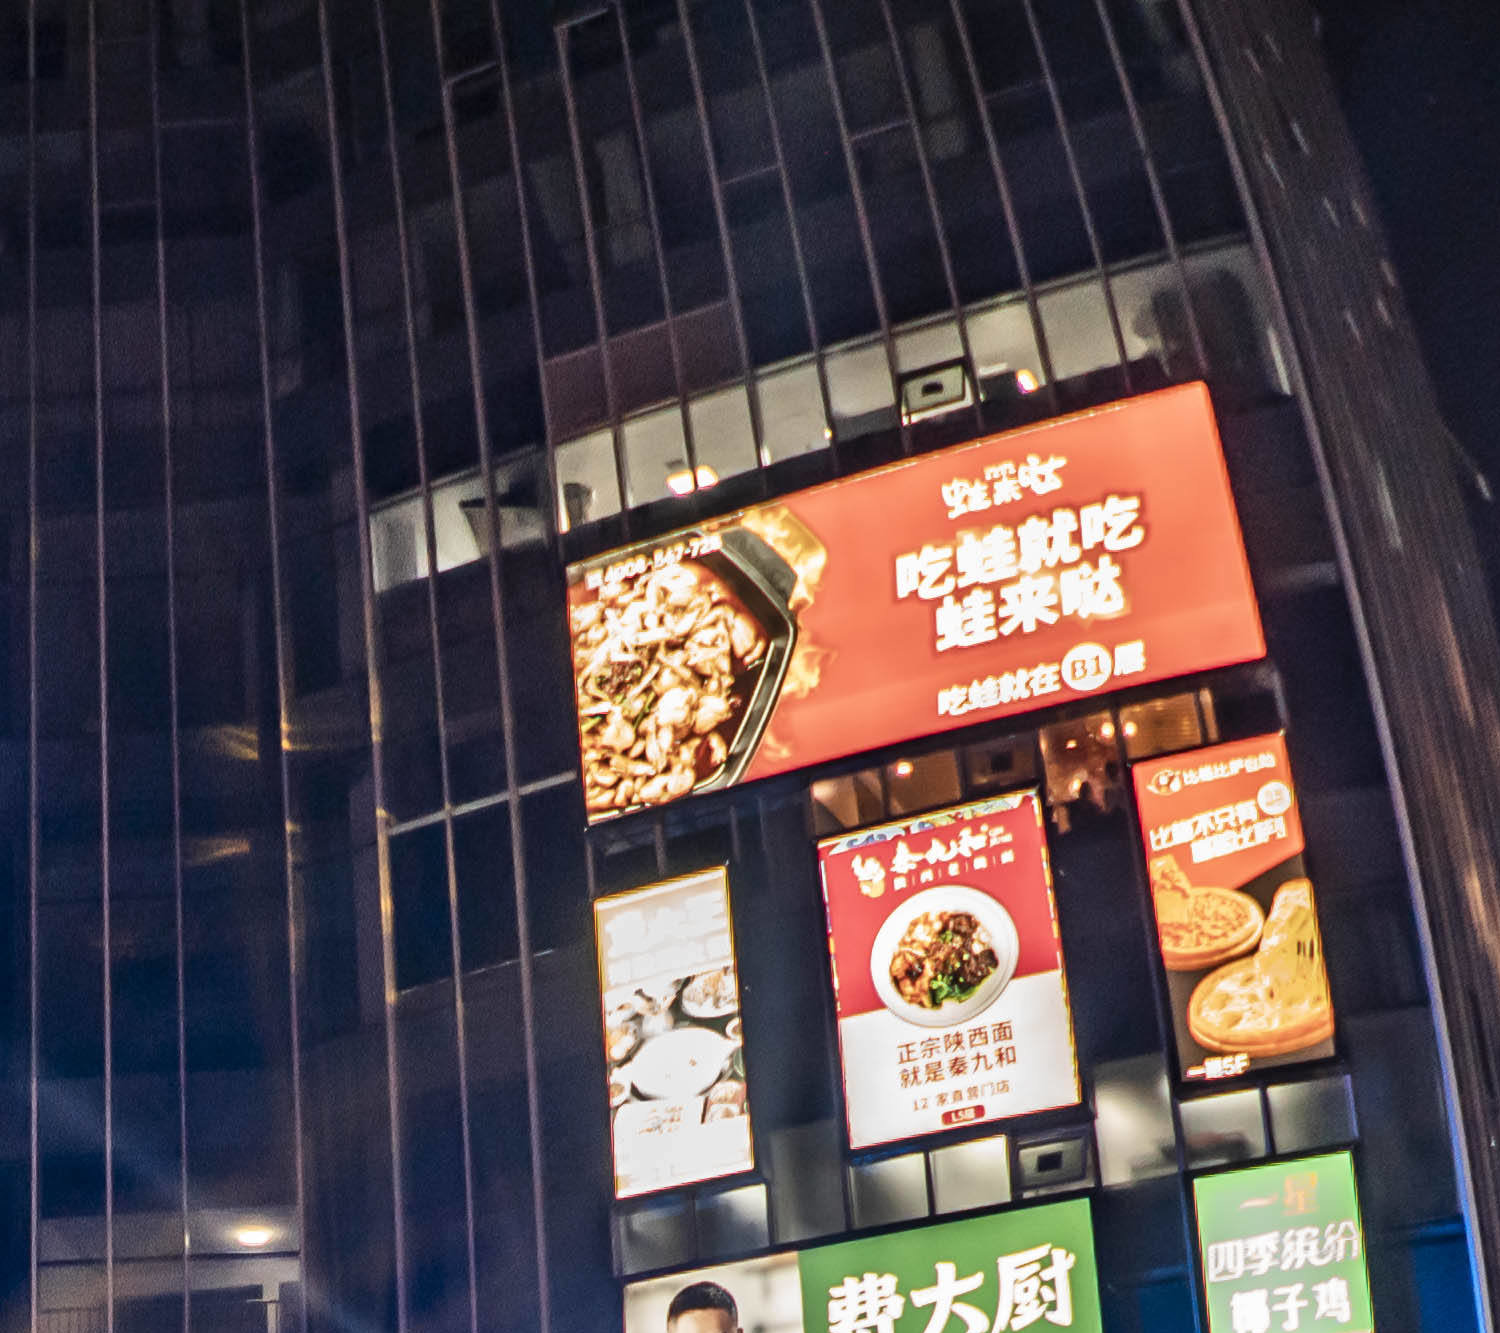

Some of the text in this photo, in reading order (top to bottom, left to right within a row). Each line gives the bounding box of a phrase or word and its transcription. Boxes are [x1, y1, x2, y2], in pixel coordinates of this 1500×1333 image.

[895, 495, 1145, 600] 吃蛙就吃
[935, 555, 1125, 652] 蛙来哒
[896, 1020, 1013, 1065] 正宗陕西面
[899, 1045, 1017, 1089] 就是秦九和
